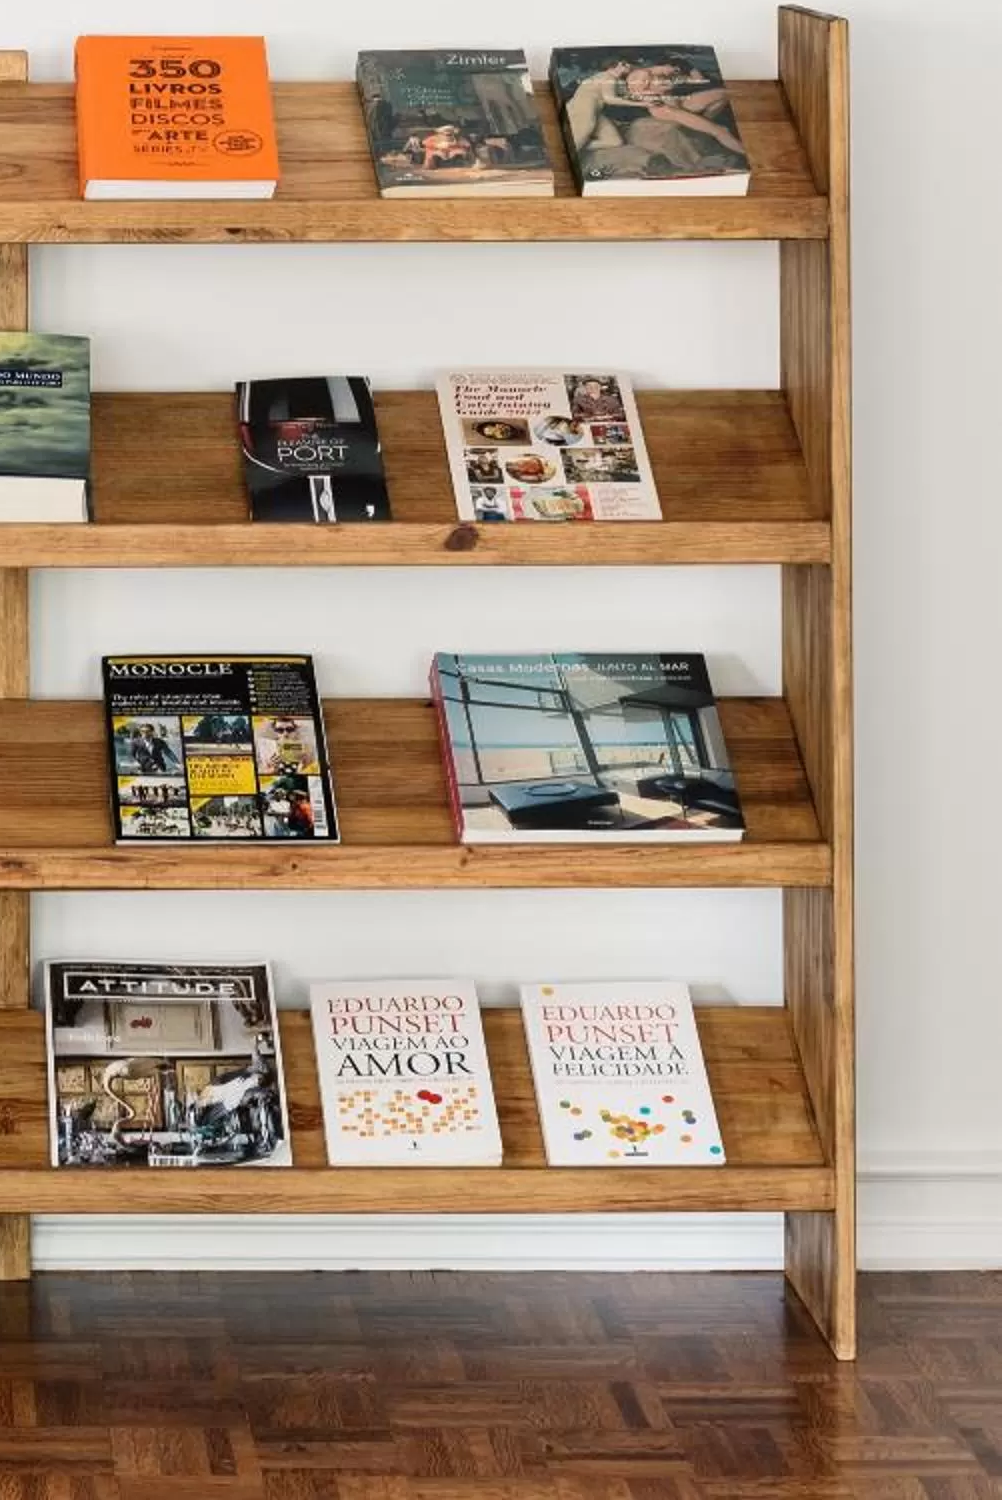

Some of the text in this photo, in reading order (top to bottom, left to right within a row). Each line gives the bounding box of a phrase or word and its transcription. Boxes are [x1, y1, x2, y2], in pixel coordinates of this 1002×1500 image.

[445, 53, 507, 66] Zimler
[129, 60, 221, 78] 350
[129, 83, 222, 95] LIVROS
[129, 97, 223, 110] FILMES
[131, 113, 225, 125] DISCOS
[148, 130, 209, 141] ARTE
[15, 372, 61, 382] MUNDO
[277, 445, 350, 462] PORT
[110, 663, 234, 676] MONOCLE
[659, 663, 690, 672] MAR
[79, 979, 236, 995] ATTITUDE
[328, 996, 464, 1013] EDUARDO
[542, 1004, 676, 1020] EDUARDO
[331, 1014, 466, 1035] PUNSET
[547, 1023, 679, 1044] PUNSET
[332, 1036, 469, 1051] VIAGEM AO
[549, 1046, 658, 1060] VIAGEM
[337, 1051, 475, 1077] AMOR
[553, 1062, 689, 1077] FELICIDADE
